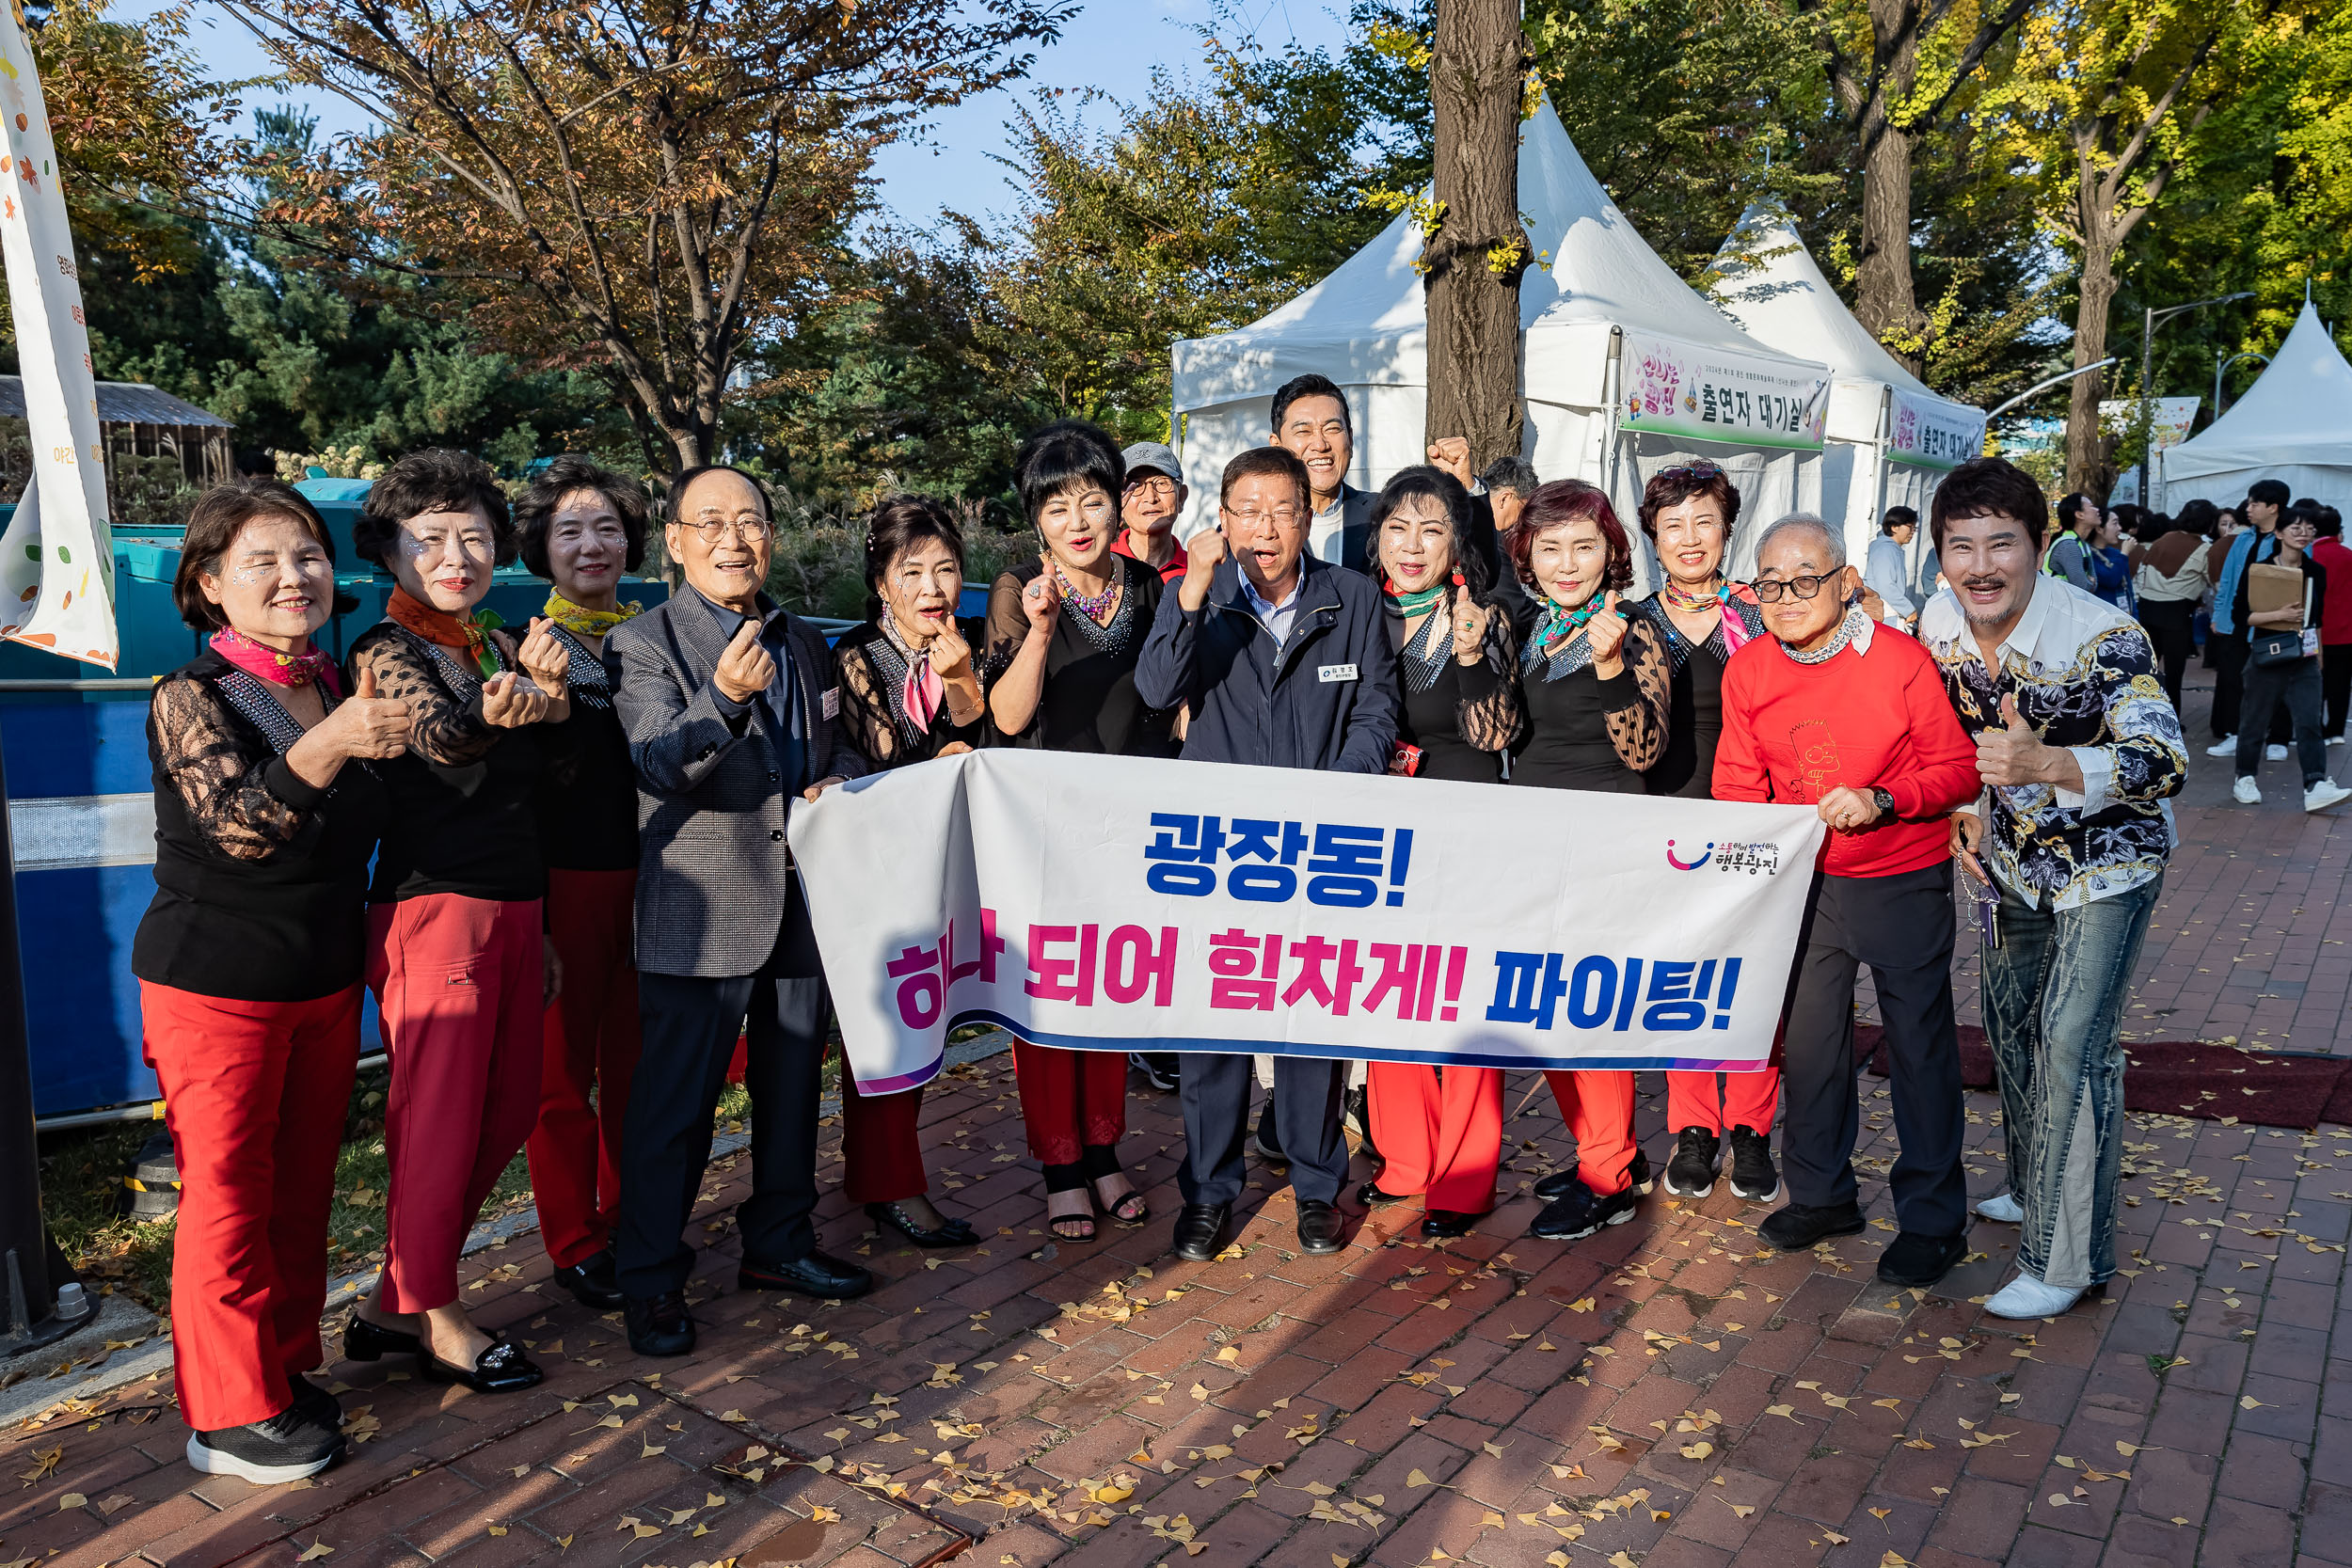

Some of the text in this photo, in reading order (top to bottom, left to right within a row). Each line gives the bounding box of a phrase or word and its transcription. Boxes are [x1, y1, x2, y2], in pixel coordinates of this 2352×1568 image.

[1645, 380, 1677, 416] 광진
[1702, 384, 1803, 433] 출연자 대기실
[54, 446, 75, 465] 야간
[1923, 425, 1973, 461] 출연자 대기실
[1144, 812, 1414, 908] 광장동!
[1715, 852, 1778, 876] 행복광진
[1719, 842, 1779, 855] 소통하며 발전하는
[885, 908, 1743, 1032] 하나 되어 힘차게! 파이팅!
